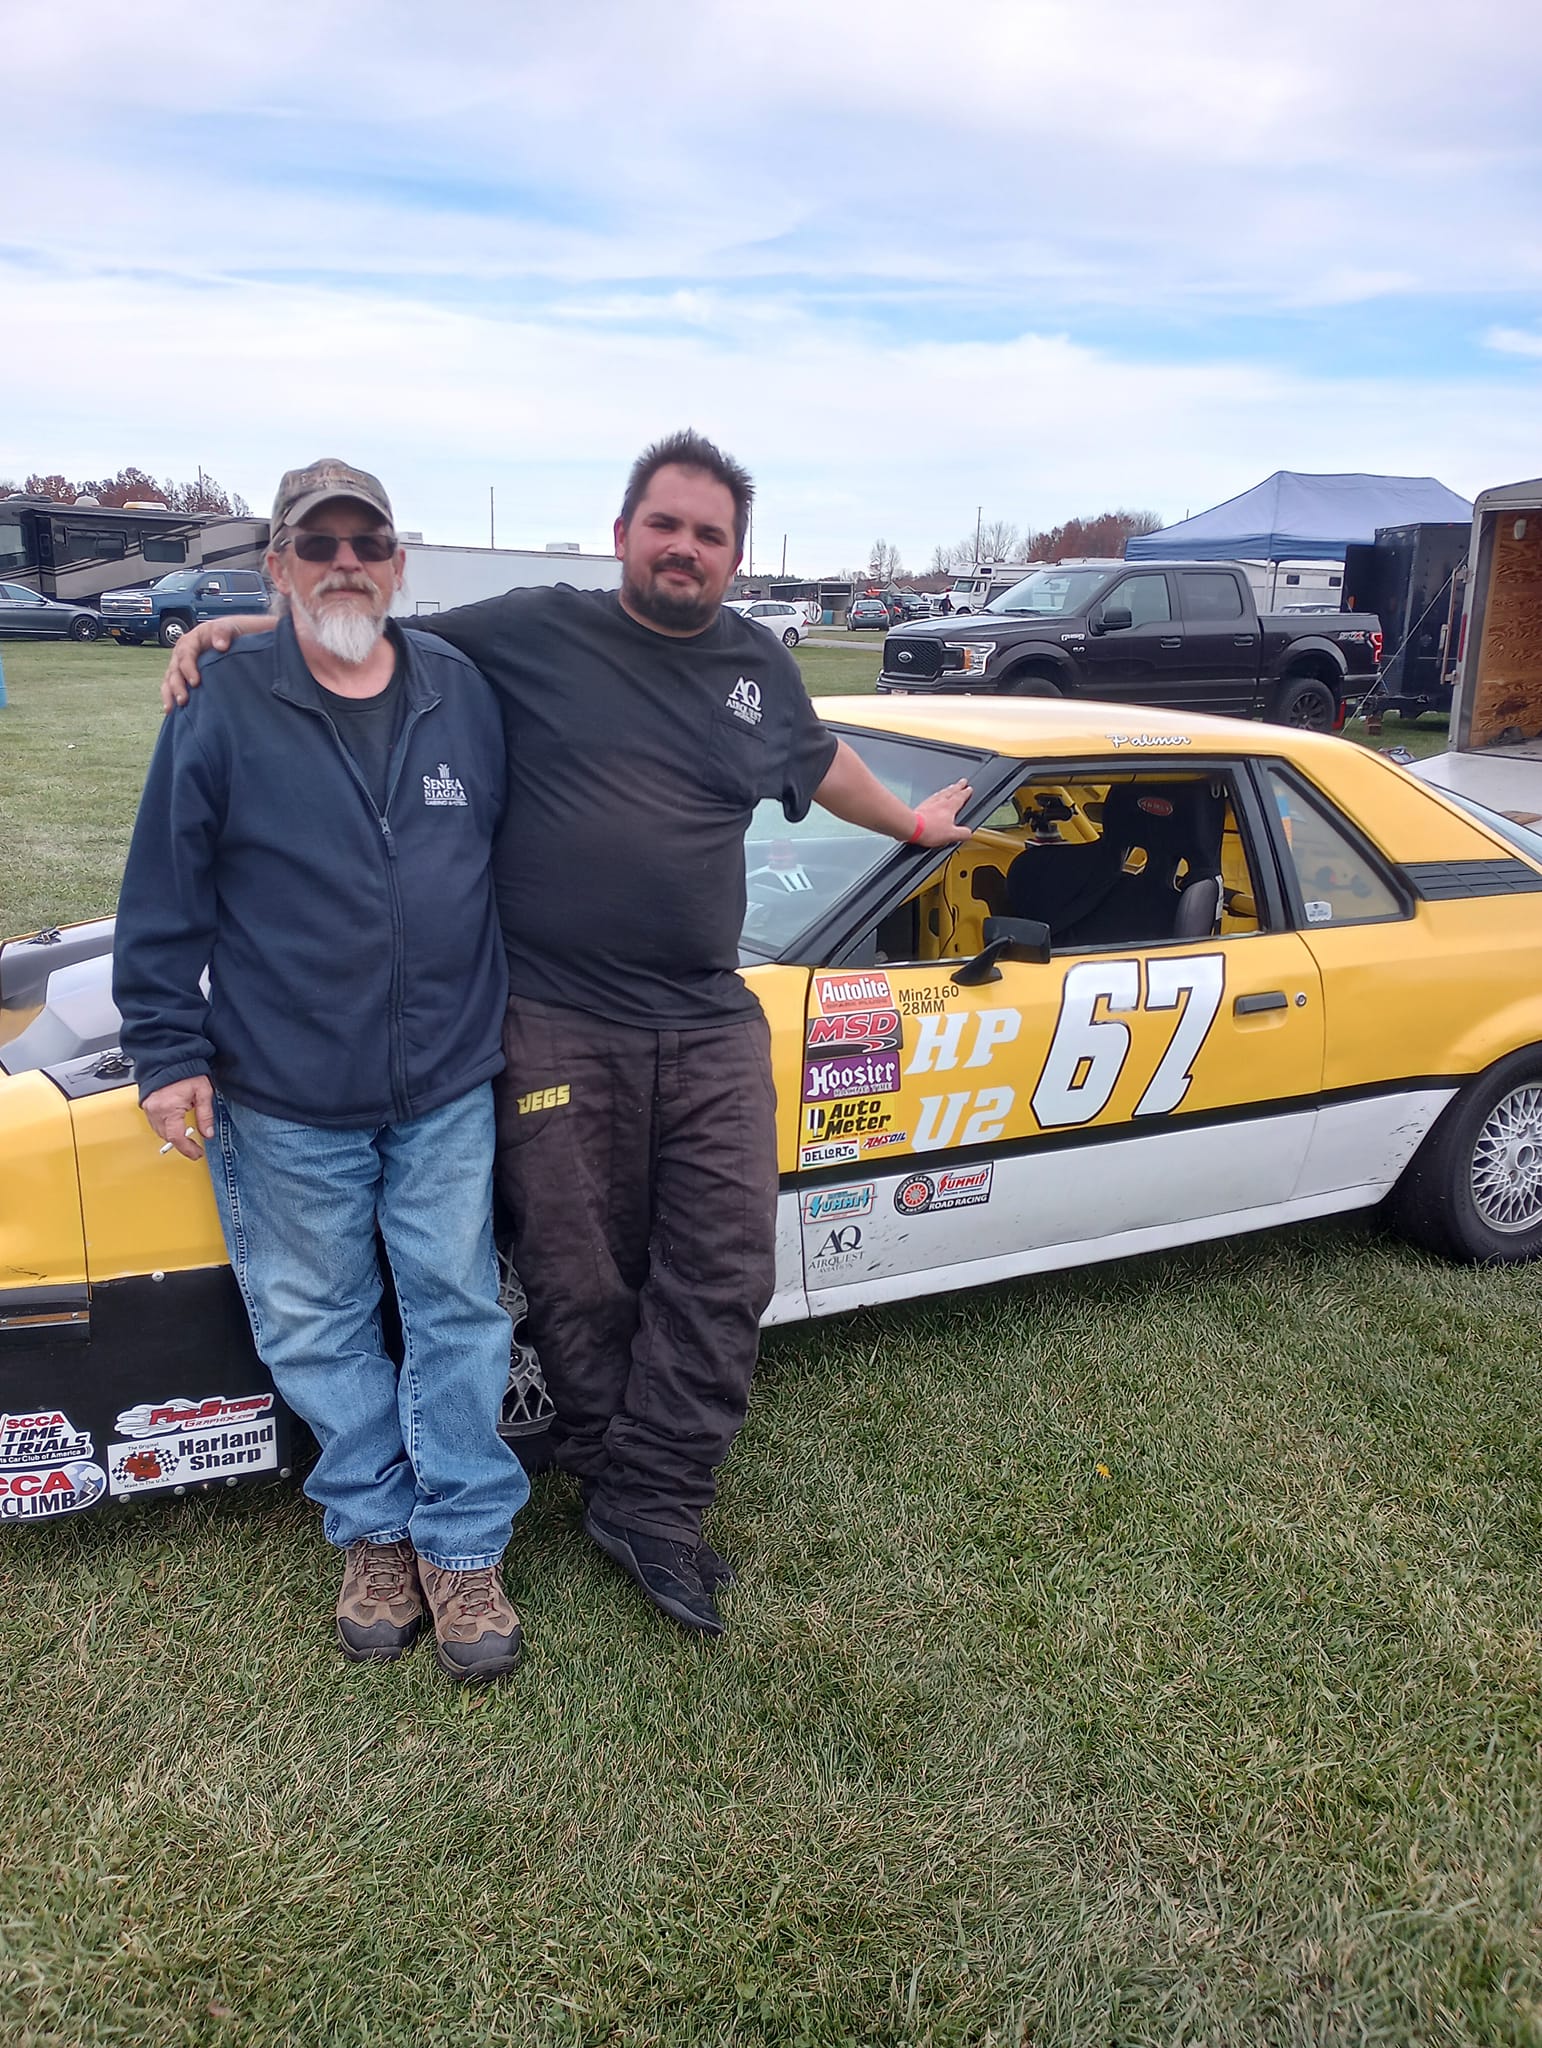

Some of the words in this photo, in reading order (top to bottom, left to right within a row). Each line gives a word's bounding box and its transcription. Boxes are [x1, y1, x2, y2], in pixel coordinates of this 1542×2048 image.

[728, 677, 762, 711] AQ
[1105, 733, 1192, 748] Palmer
[822, 978, 889, 1003] Autolite
[899, 985, 959, 1002] Min2160
[902, 1000, 945, 1015] 28MM
[808, 1011, 898, 1044] MSD
[1030, 952, 1226, 1129] 67
[806, 1057, 896, 1096] Hoosier
[517, 1084, 570, 1115] JEGS
[829, 1100, 881, 1120] Auto
[825, 1114, 891, 1141] Meter
[863, 1132, 906, 1148] AMSOIL
[929, 1200, 954, 1211] ROAD
[955, 1194, 988, 1206] RACING
[813, 1225, 863, 1259] AQ
[6, 1413, 65, 1430] SCCA
[4, 1425, 65, 1442] TIME
[178, 1425, 274, 1456] Harland
[1, 1435, 89, 1456] TRIALS
[50, 1449, 81, 1459] America
[190, 1448, 261, 1471] Sharp
[0, 1491, 77, 1516] CLIMB
